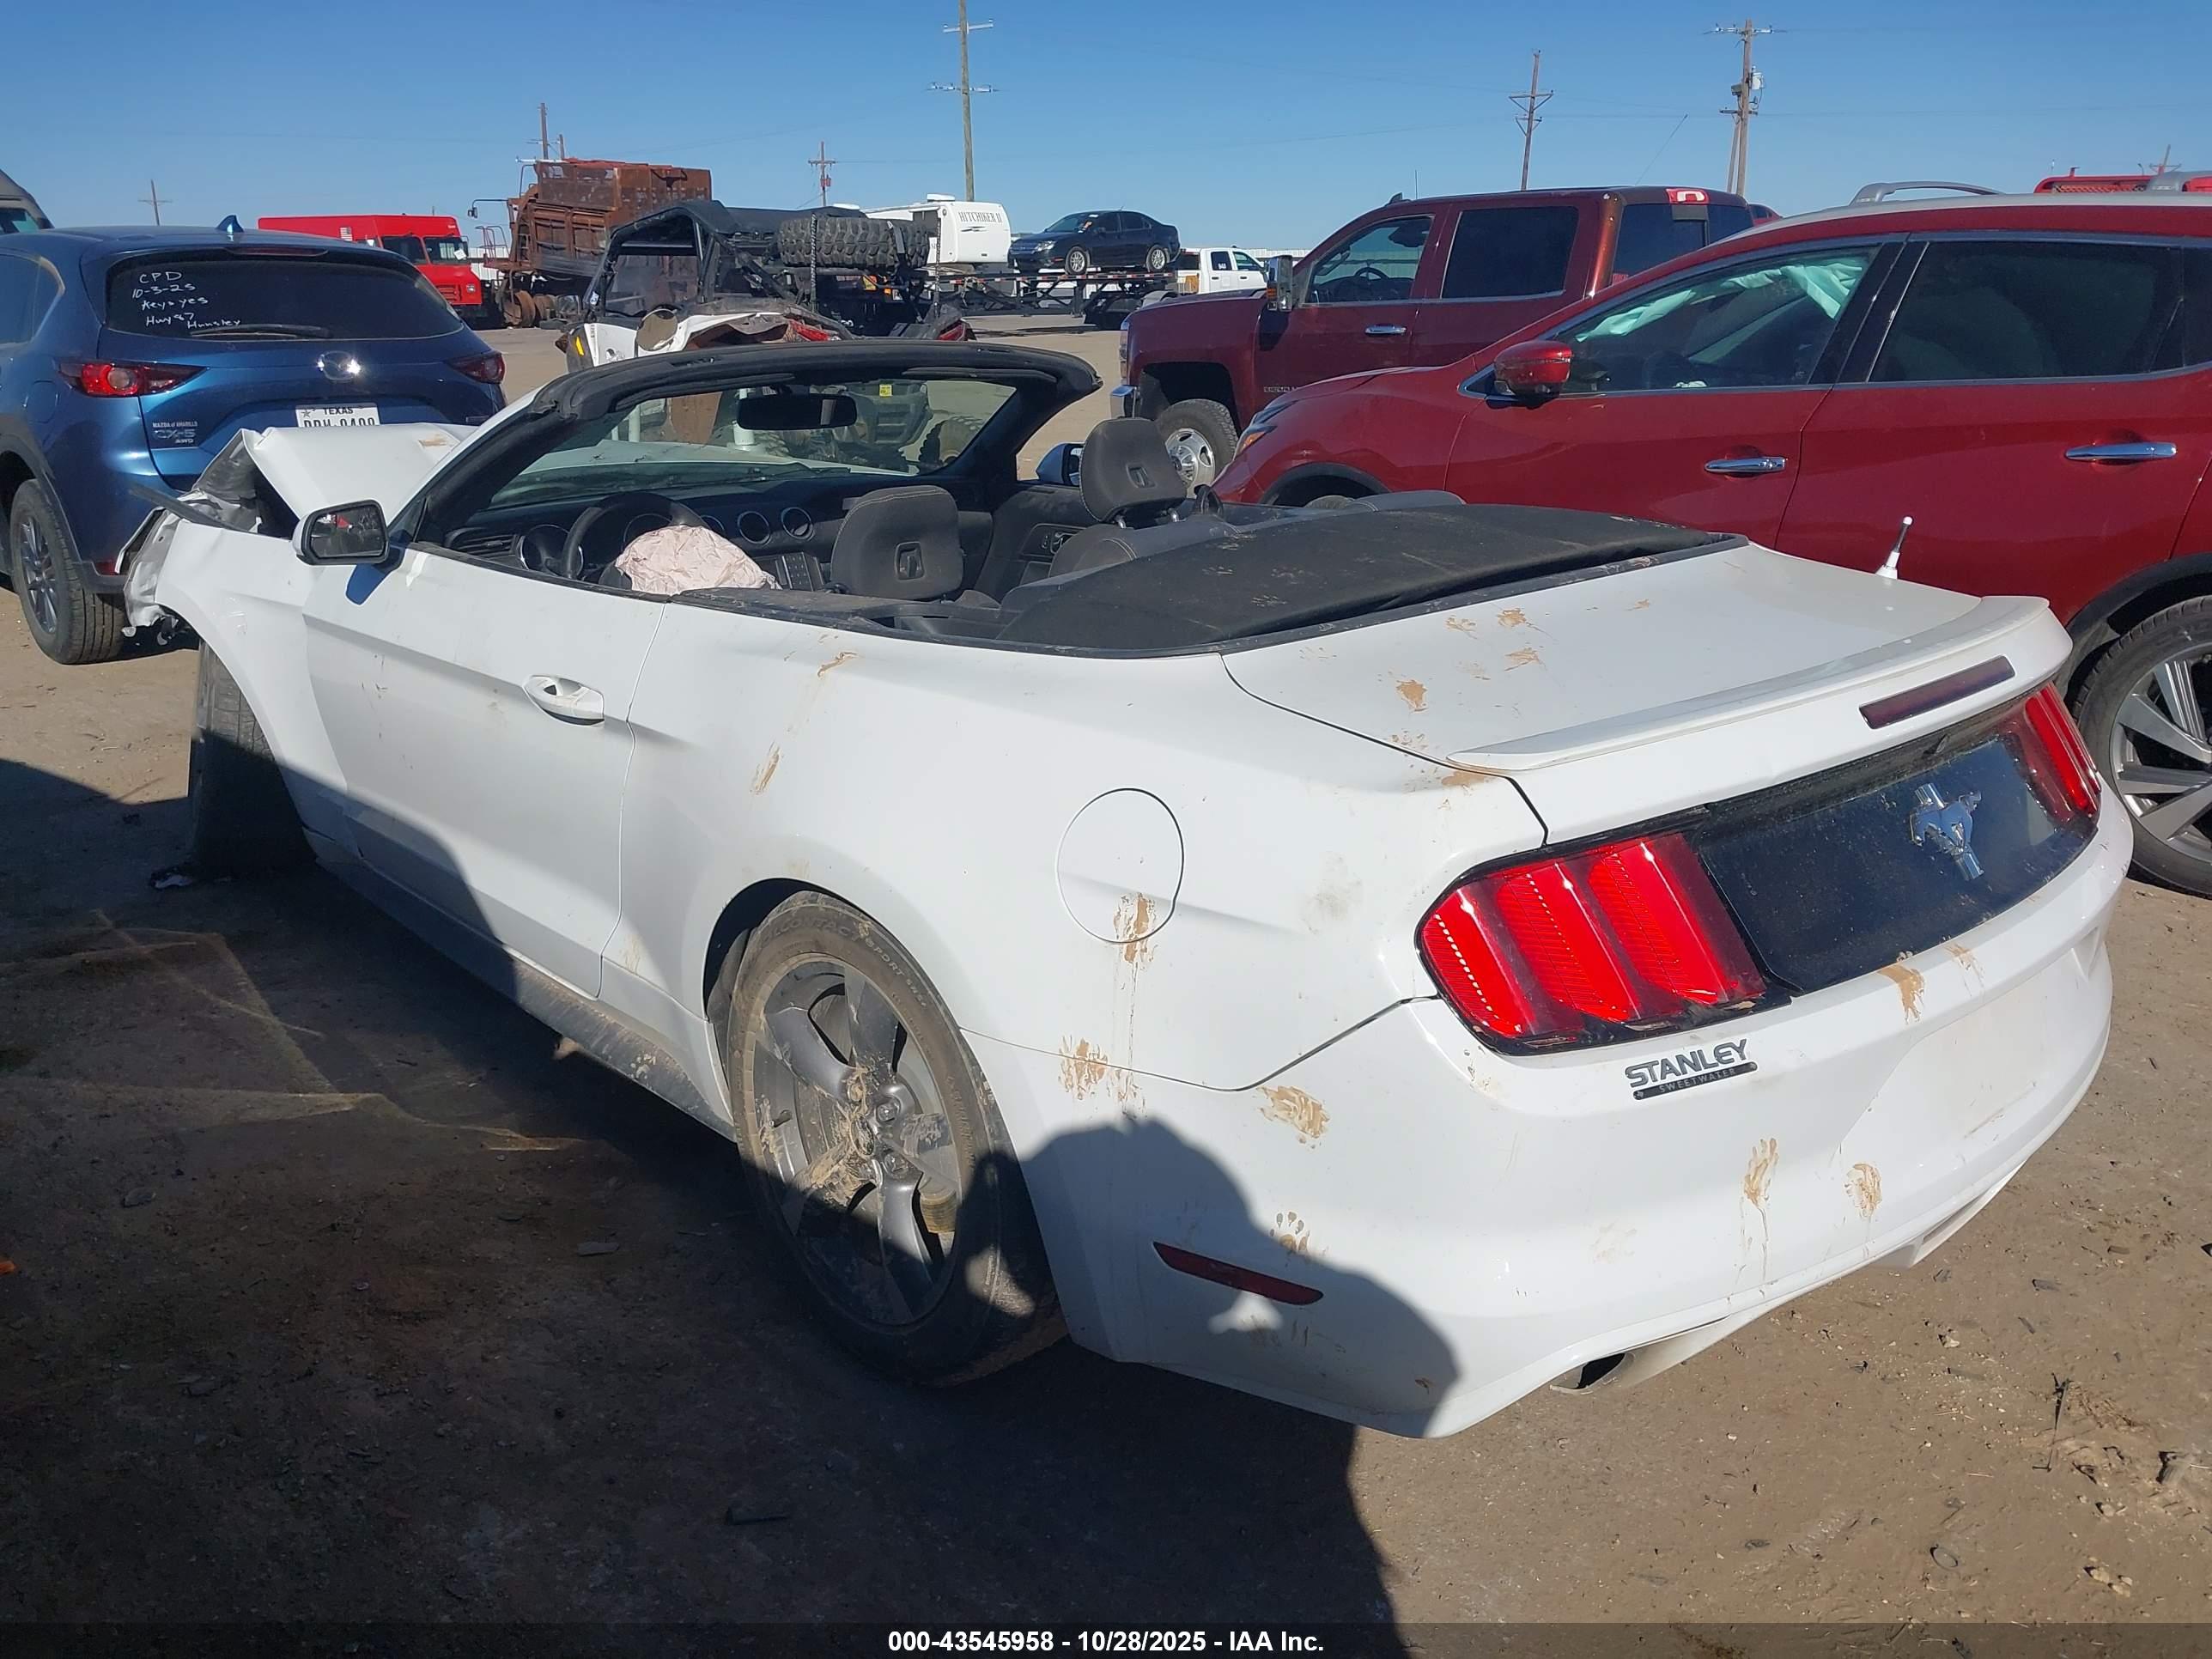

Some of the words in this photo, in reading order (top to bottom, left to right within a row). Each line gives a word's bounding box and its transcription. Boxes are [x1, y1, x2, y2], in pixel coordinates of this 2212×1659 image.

[139, 271, 182, 283] CPD
[323, 406, 354, 415] TEXAS
[155, 429, 197, 439] CX-5
[1625, 1038, 1747, 1088] STANLEY
[1658, 1068, 1736, 1092] SWEETWATER
